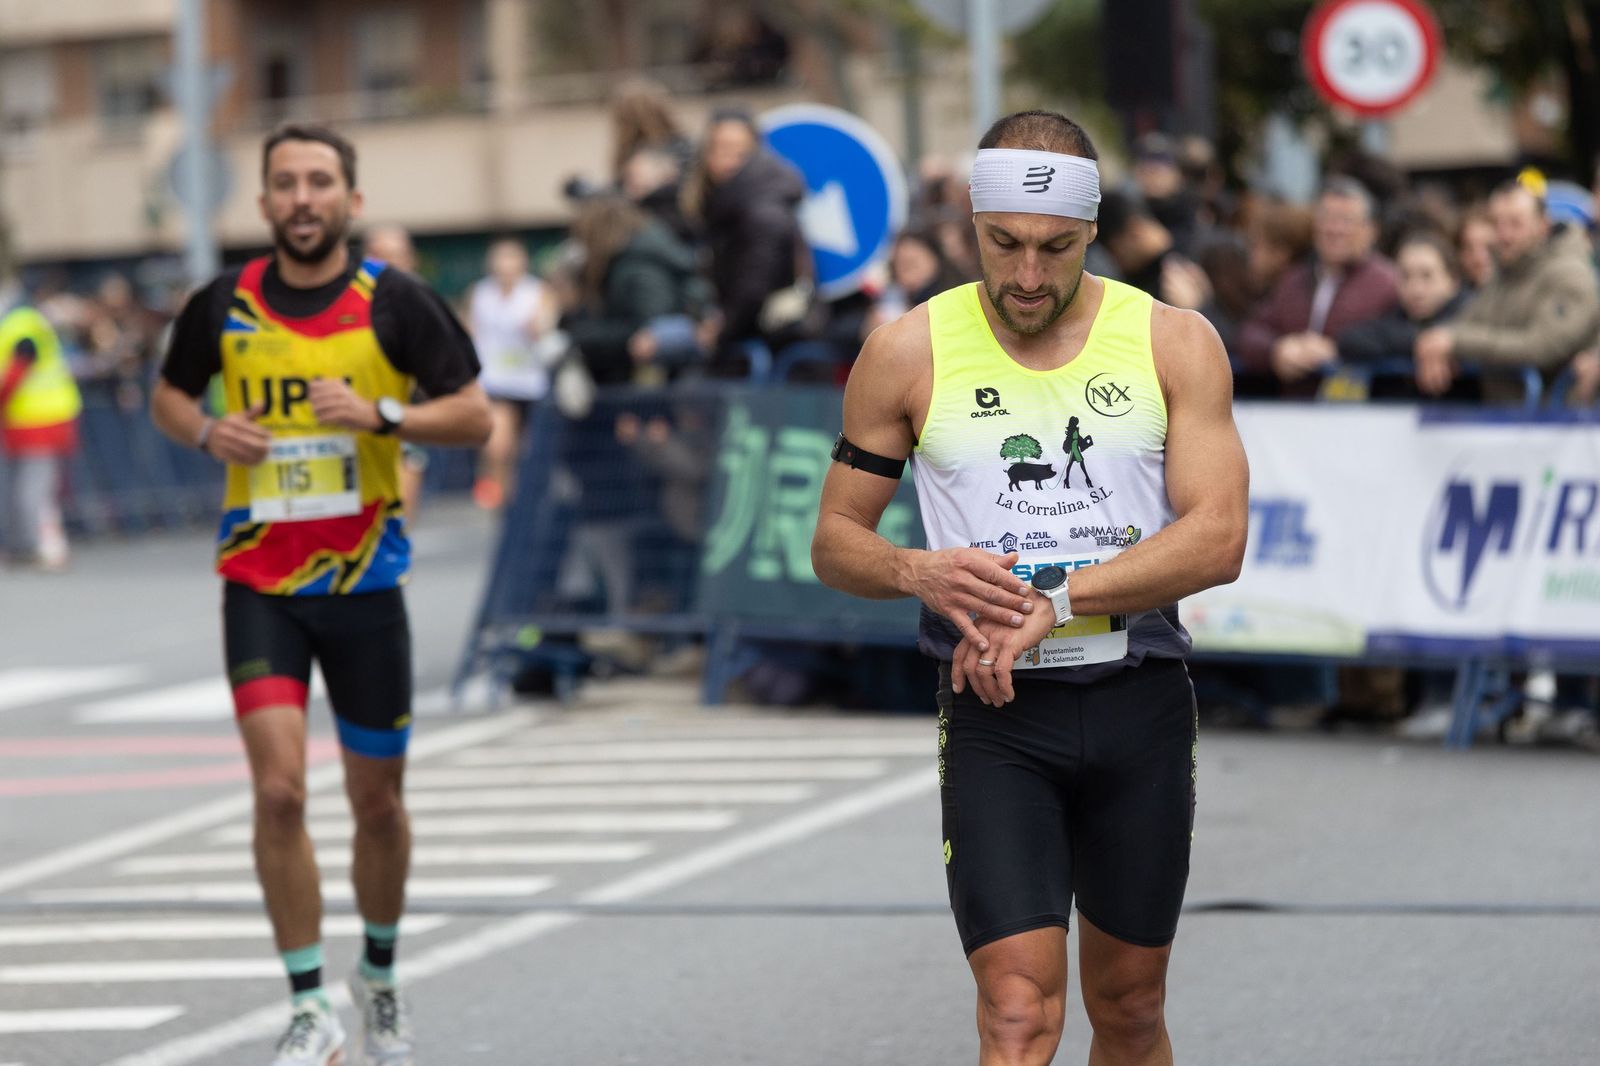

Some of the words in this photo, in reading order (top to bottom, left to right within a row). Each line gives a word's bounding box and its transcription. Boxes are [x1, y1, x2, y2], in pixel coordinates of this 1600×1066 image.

[240, 377, 352, 418] UP
[1090, 382, 1131, 407] NYX
[995, 492, 1013, 510] La
[1017, 500, 1090, 516] Corralina,
[1089, 486, 1114, 504] S.L.
[1025, 531, 1052, 541] AZUL
[1019, 540, 1058, 551] TELECO
[1042, 645, 1085, 657] Ayuntamiento
[1043, 656, 1051, 664] de
[1052, 655, 1085, 664] Salamanca
